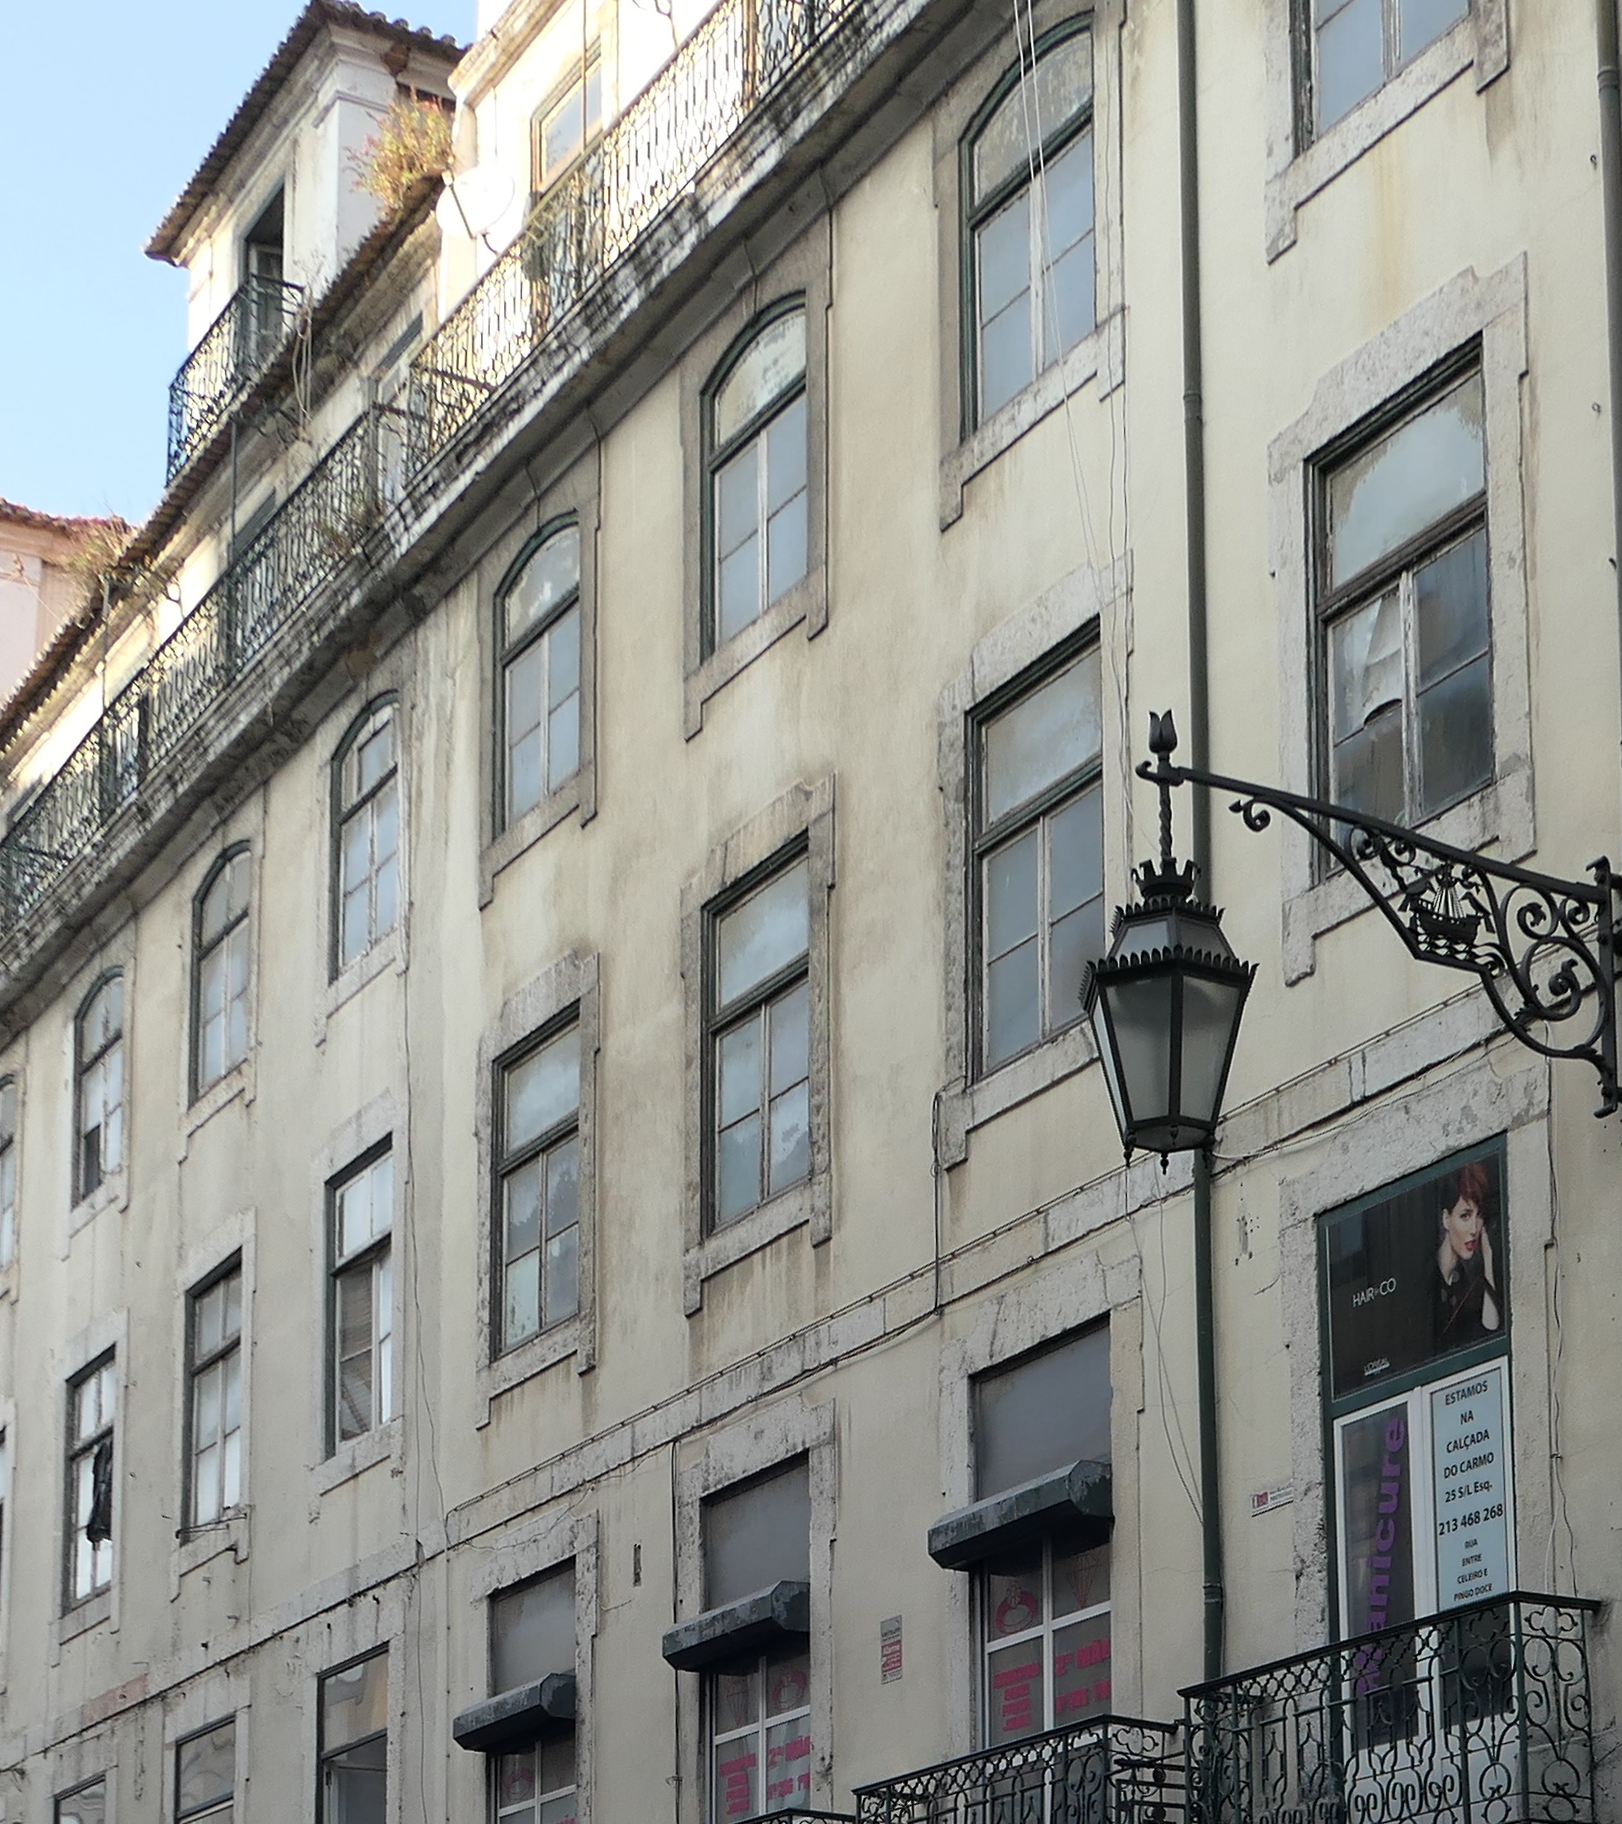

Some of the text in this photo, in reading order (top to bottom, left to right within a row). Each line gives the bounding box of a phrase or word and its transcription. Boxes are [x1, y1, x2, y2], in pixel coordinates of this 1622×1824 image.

[1445, 1380, 1489, 1407] ESTAMOS
[1460, 1410, 1474, 1425] NA
[1446, 1428, 1490, 1455] CALÇADA
[1444, 1451, 1494, 1480] DO CARMO
[1445, 1490, 1456, 1503] 25
[1438, 1502, 1503, 1537] 213 468 268
